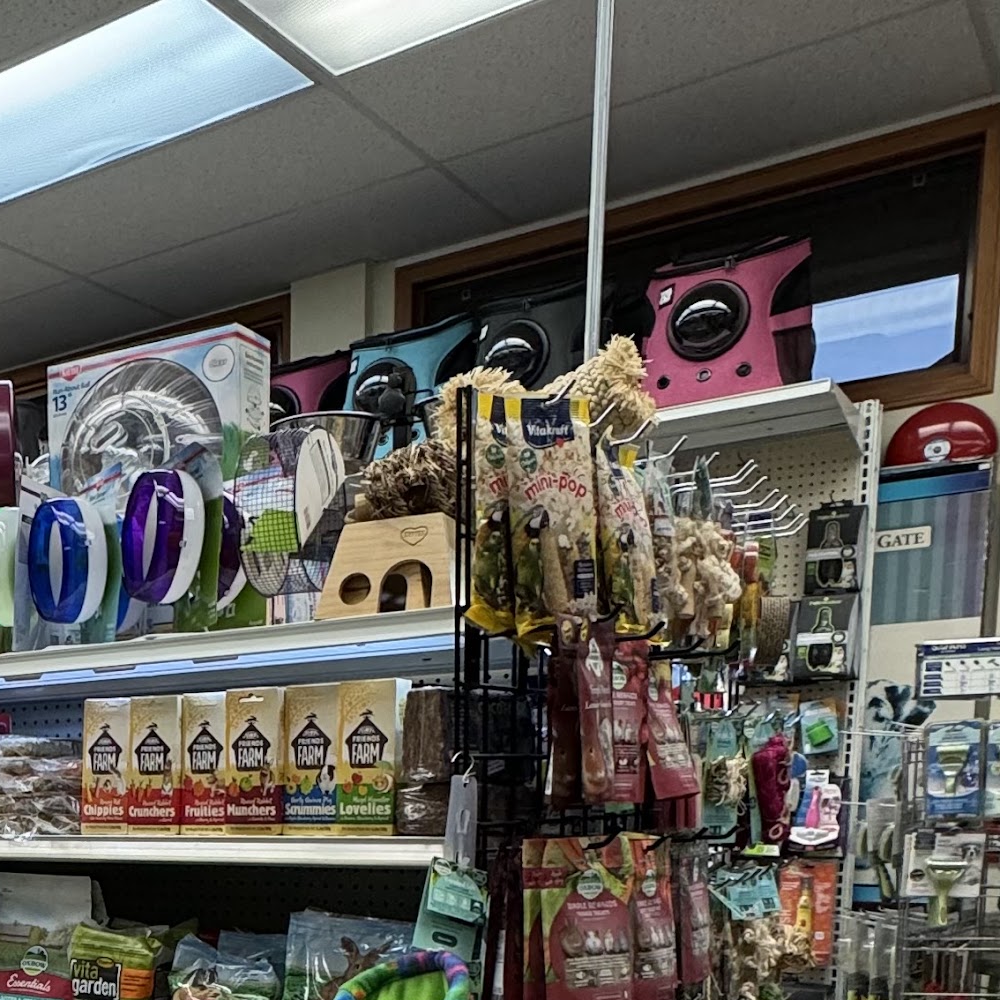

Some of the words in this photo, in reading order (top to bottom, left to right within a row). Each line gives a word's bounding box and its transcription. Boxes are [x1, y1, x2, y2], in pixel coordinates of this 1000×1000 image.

[526, 422, 571, 436] Vitakraft
[524, 474, 587, 500] mini-pop
[878, 532, 925, 548] GATE
[93, 752, 116, 771] FARM
[140, 752, 164, 772] FARM
[192, 751, 216, 770] FARM
[238, 748, 263, 767] FARM
[298, 746, 324, 766] FARM
[352, 743, 380, 765] FARM
[83, 804, 124, 816] Chippies
[128, 805, 175, 817] Crunchers
[185, 805, 225, 817] Fruities
[227, 804, 276, 816] Munchers
[285, 804, 336, 816] Scrummies
[340, 802, 391, 815] Lovelies
[73, 961, 99, 979] vita
[7, 973, 51, 992] Essentials
[72, 977, 117, 997] garden
